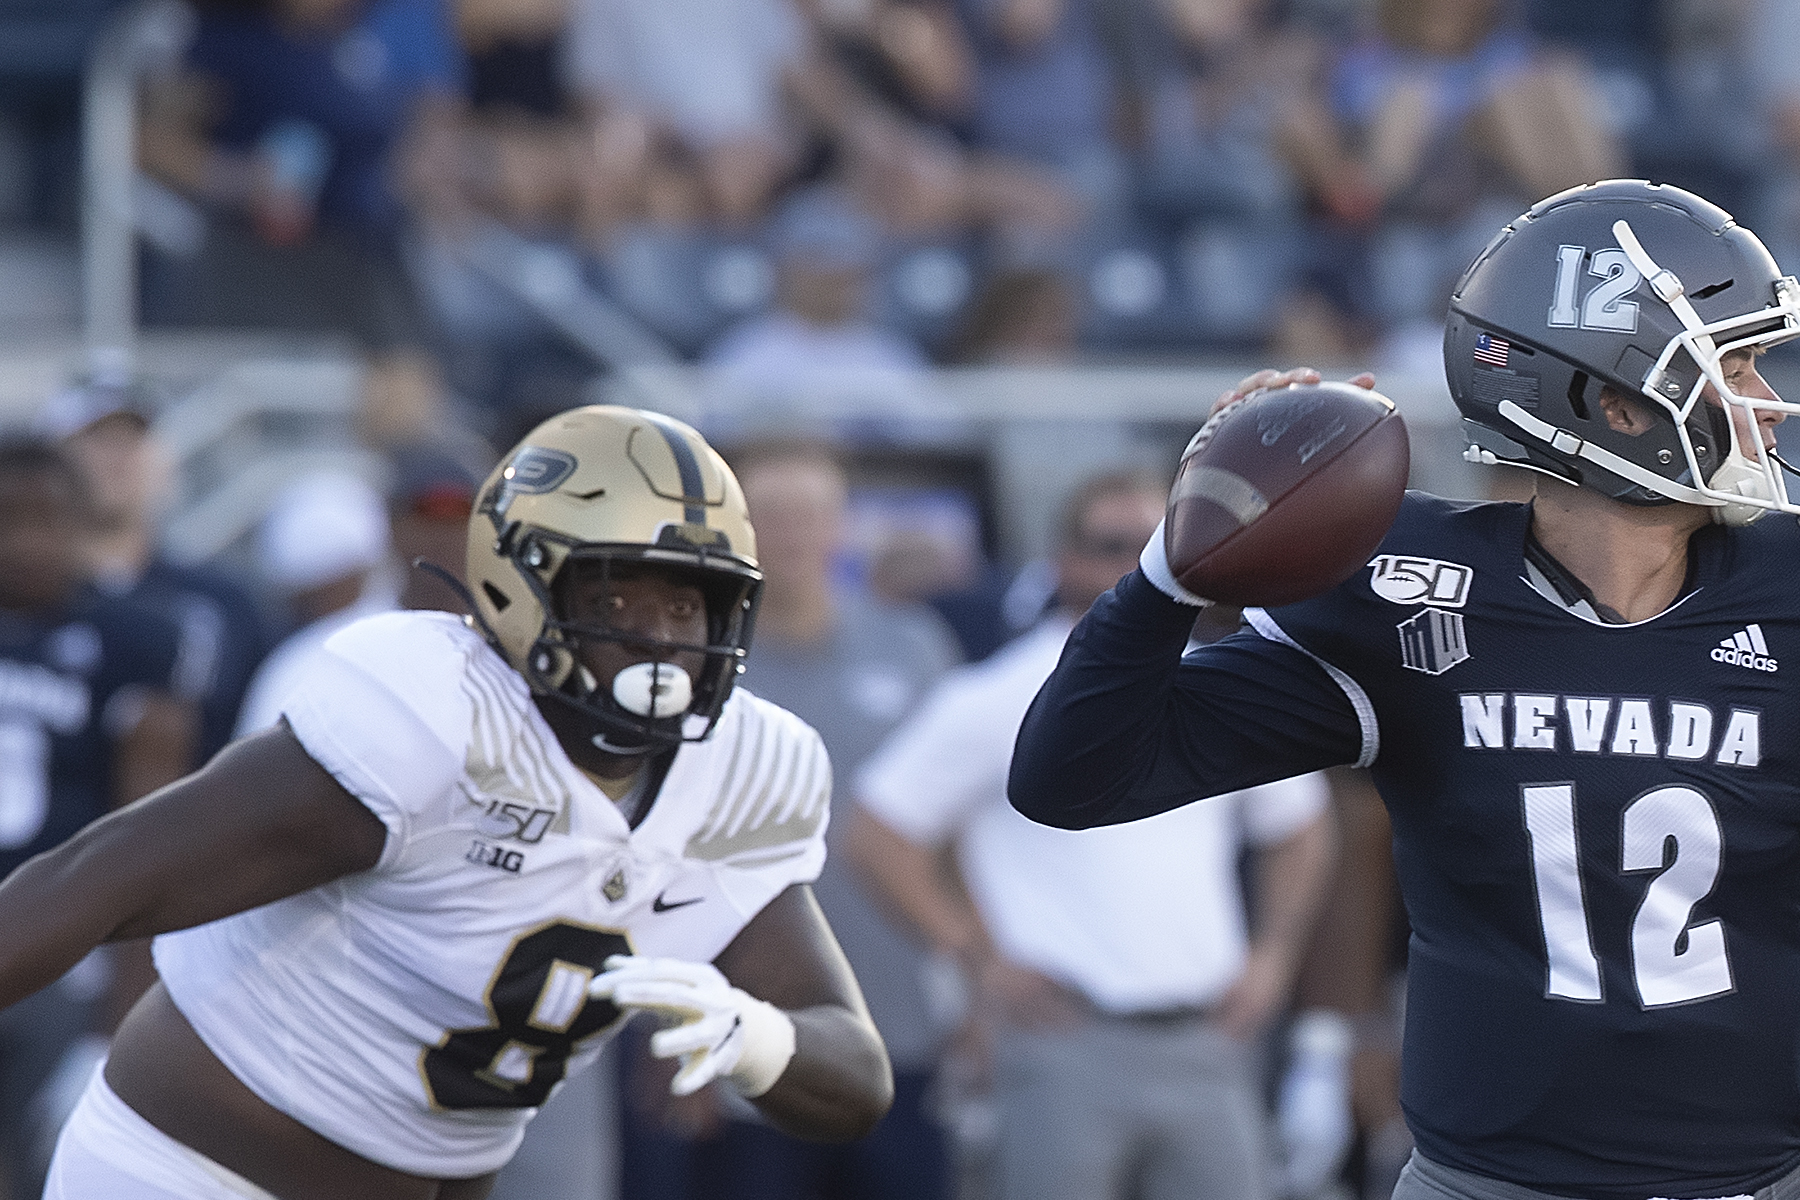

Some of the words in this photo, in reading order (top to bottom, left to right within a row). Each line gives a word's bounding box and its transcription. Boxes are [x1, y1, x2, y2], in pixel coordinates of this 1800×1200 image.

[1547, 244, 1643, 335] 12
[1367, 554, 1474, 608] 150
[1710, 647, 1779, 673] adidas
[1459, 692, 1761, 768] NEVADA
[1519, 781, 1737, 1011] 12
[417, 916, 637, 1113] 8
